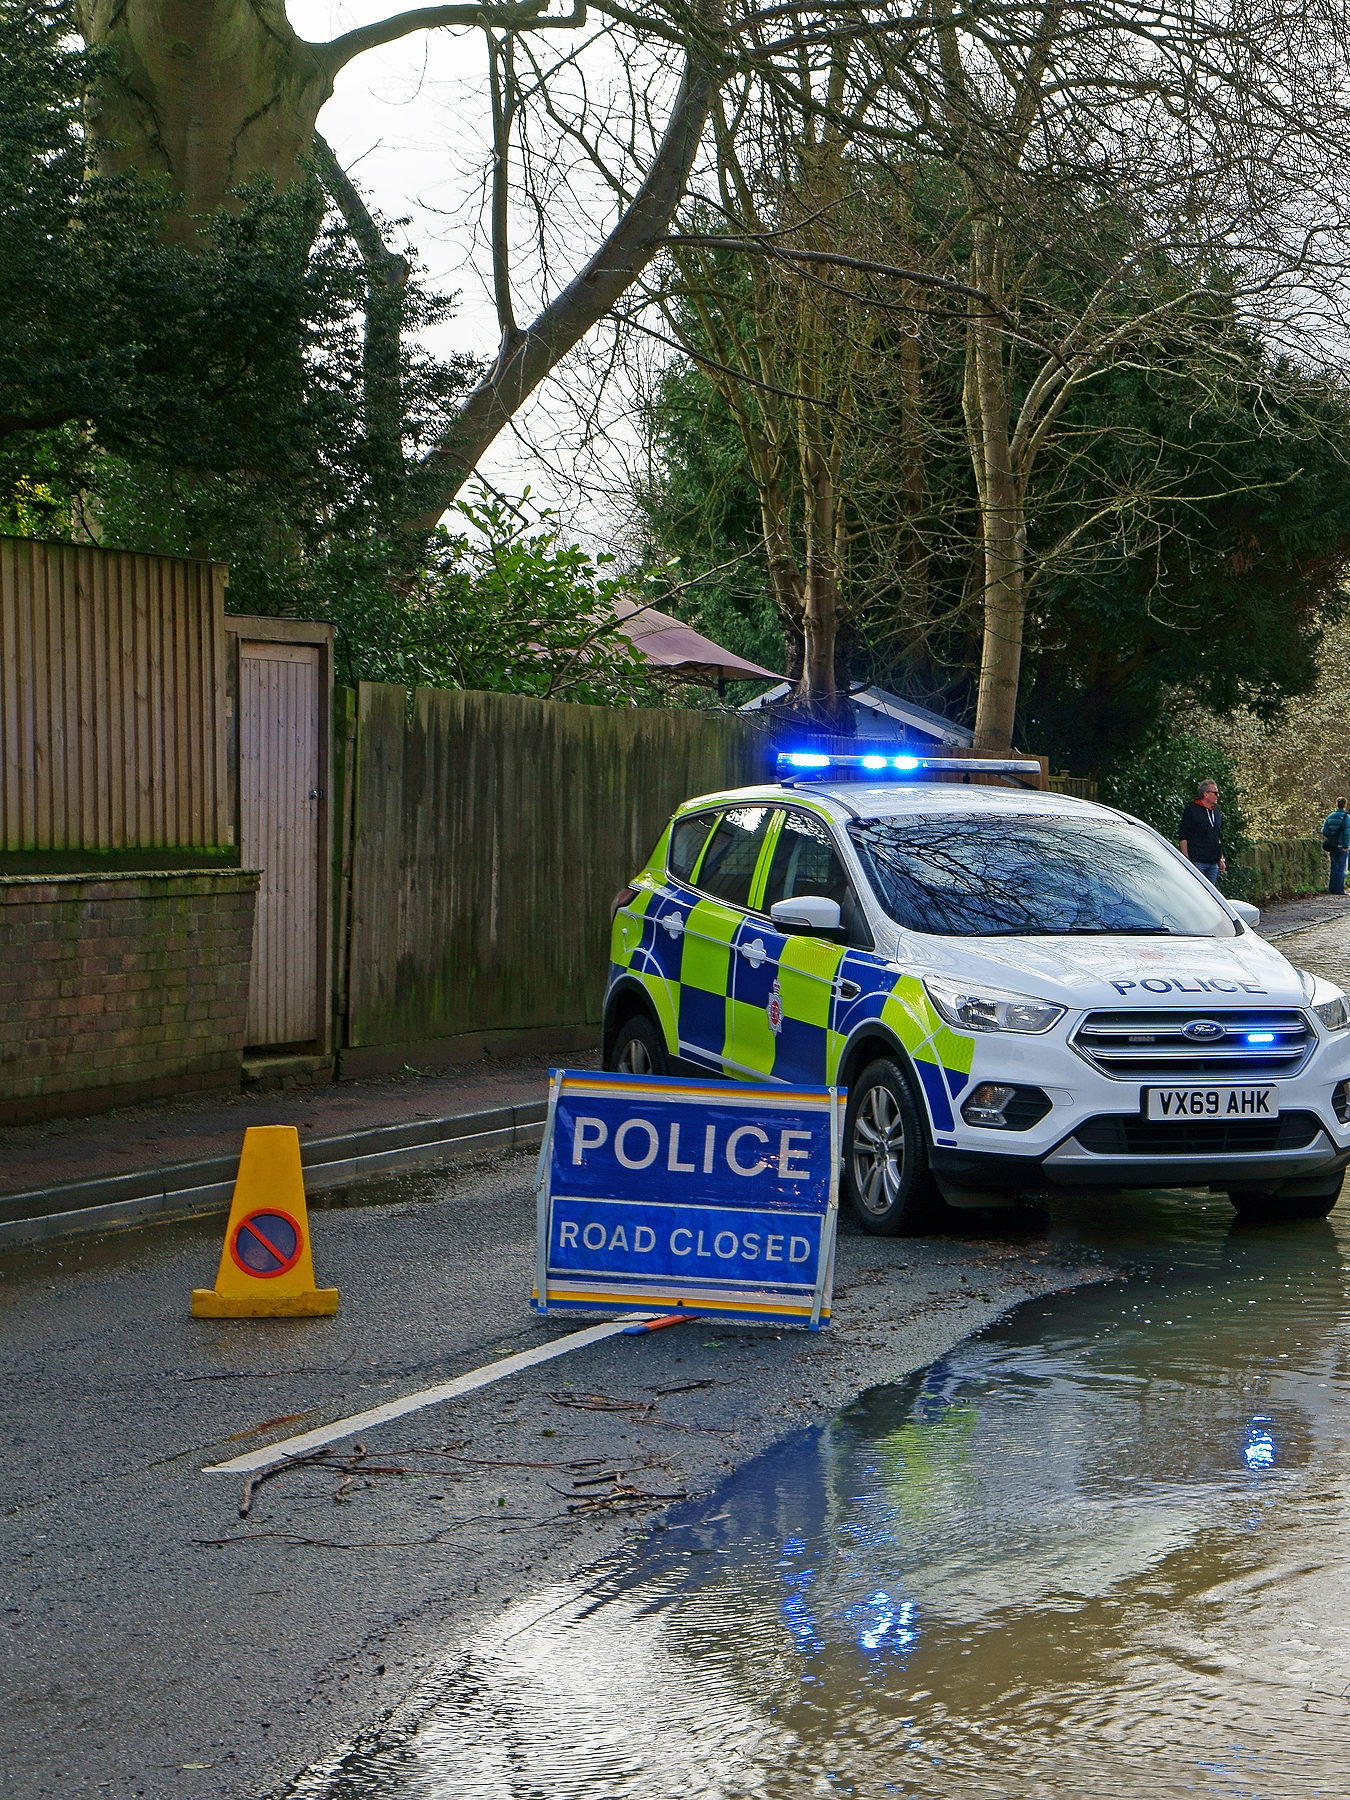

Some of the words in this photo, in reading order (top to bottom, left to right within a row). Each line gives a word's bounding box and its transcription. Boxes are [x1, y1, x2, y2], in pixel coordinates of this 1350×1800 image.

[1109, 977, 1268, 996] POLICE
[1159, 1091, 1220, 1115] VX69
[1226, 1090, 1270, 1114] AHK
[571, 1116, 812, 1180] POLICE
[559, 1221, 657, 1253] ROAD
[669, 1228, 811, 1263] CLOSED
